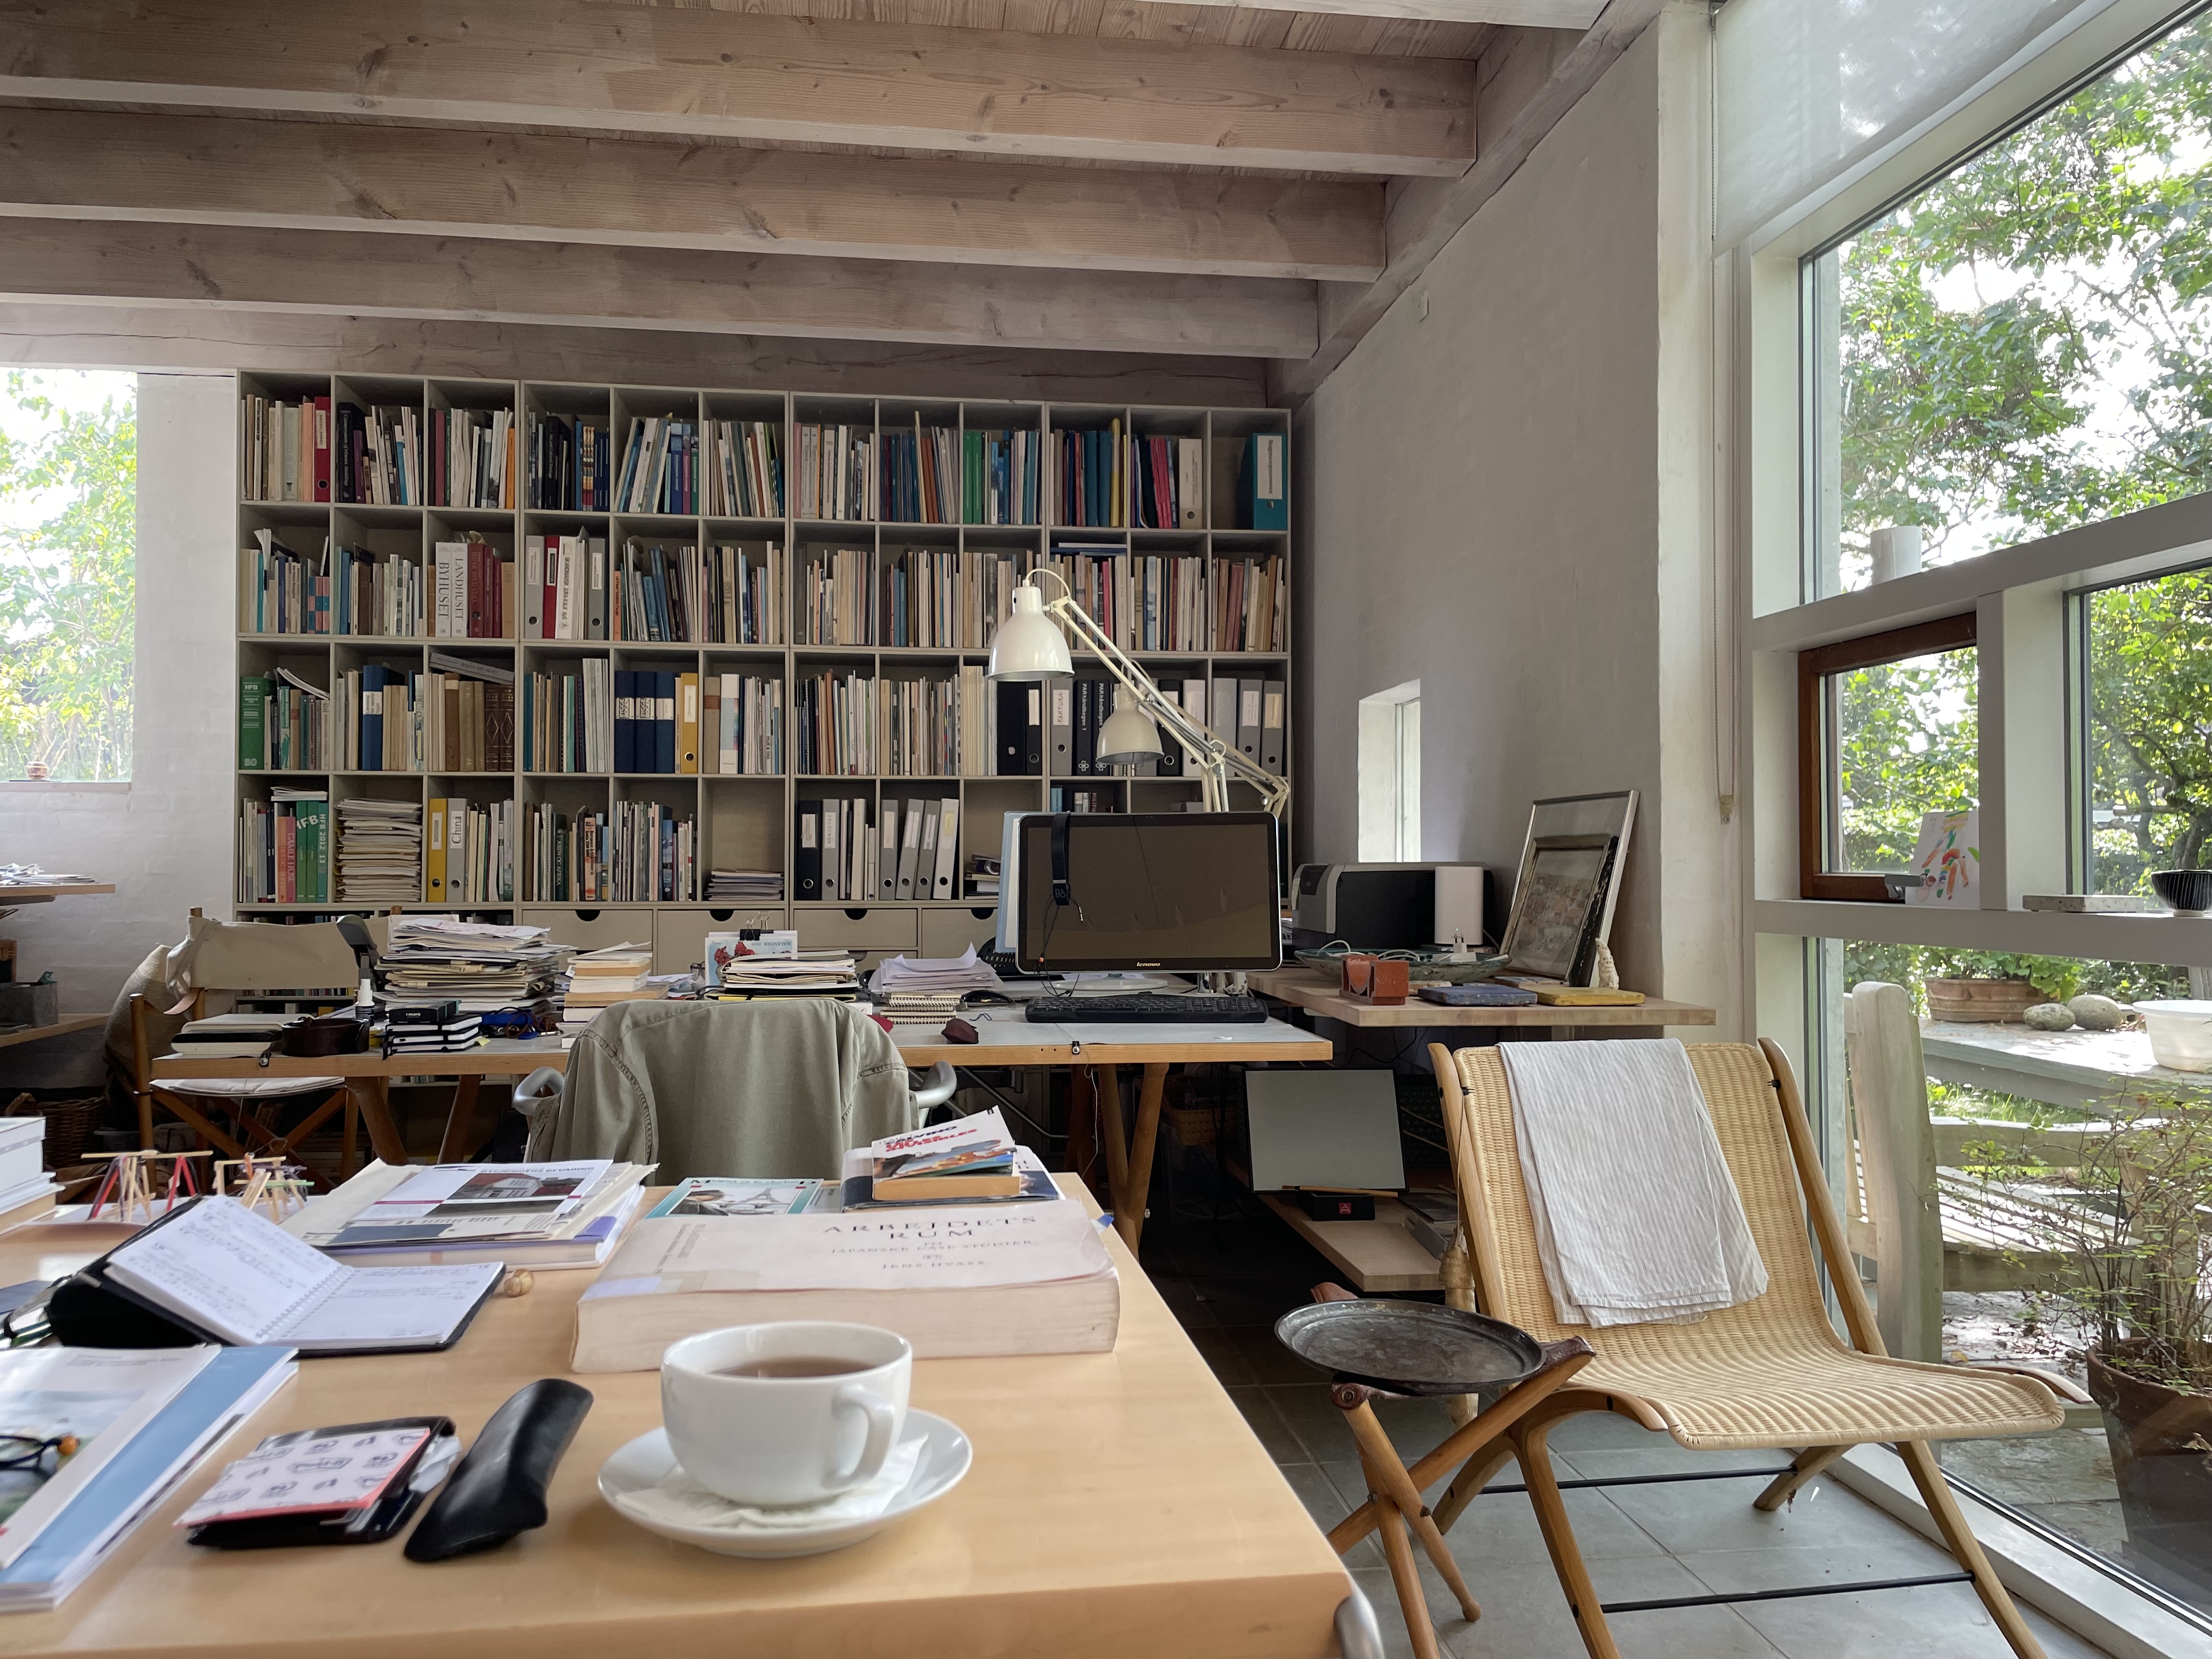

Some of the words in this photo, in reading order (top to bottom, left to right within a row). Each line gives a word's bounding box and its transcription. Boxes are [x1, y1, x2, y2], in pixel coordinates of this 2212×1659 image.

[438, 562, 450, 619] BYHUSET
[455, 558, 464, 620] LANDHUSET
[451, 816, 462, 844] China
[287, 860, 295, 882] HUSE
[823, 1216, 1036, 1233] ARBEJDETS
[888, 1229, 973, 1239] RUM
